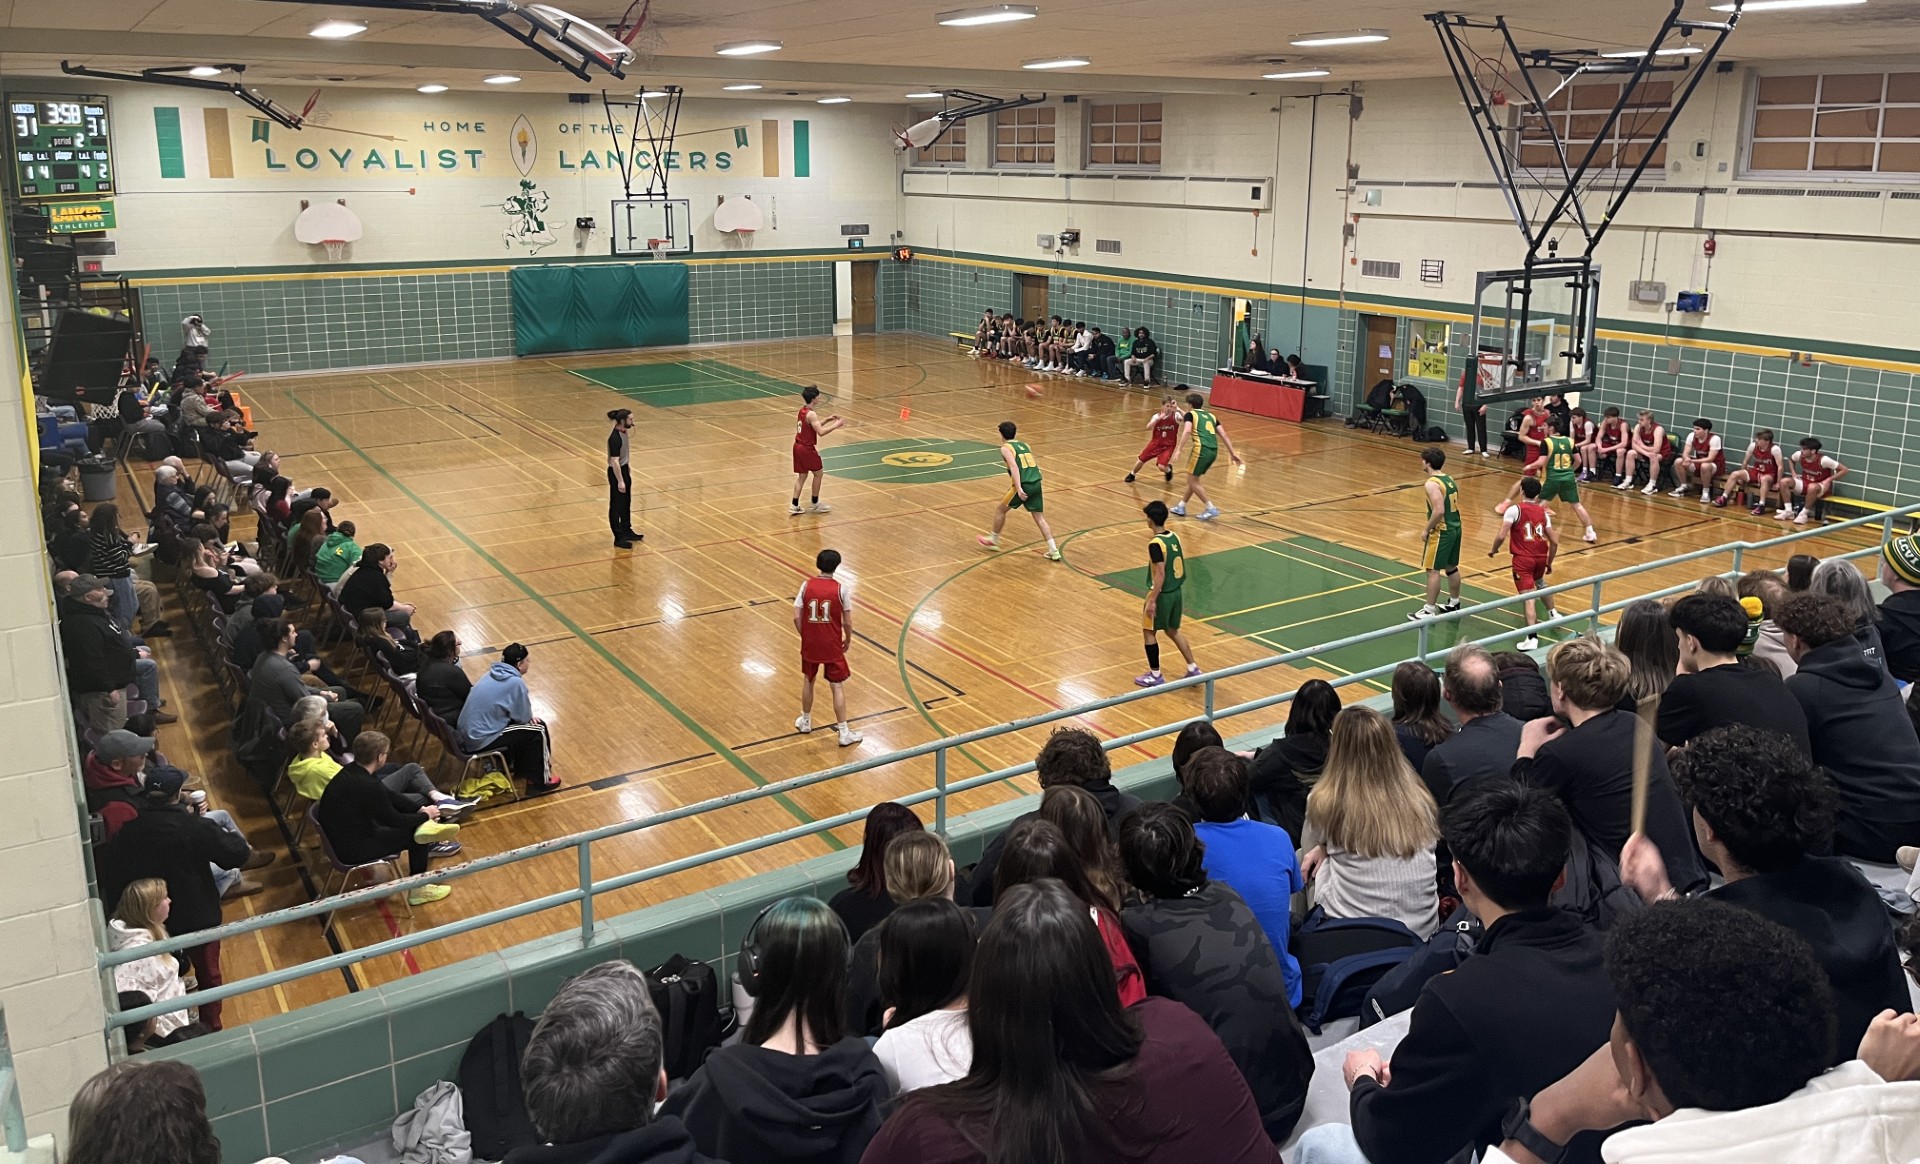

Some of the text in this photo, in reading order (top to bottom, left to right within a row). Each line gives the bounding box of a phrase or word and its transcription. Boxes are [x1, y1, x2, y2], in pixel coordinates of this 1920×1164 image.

[47, 103, 81, 124] 3:58
[16, 116, 38, 136] 31
[87, 117, 107, 136] 31
[424, 121, 624, 134] HOME OF THE
[265, 147, 733, 170] LOYALIST LANCERS
[53, 221, 105, 230] ATHLETICS
[1524, 521, 1546, 541] 14
[1898, 538, 1919, 565] LCVI
[807, 598, 832, 624] 11
